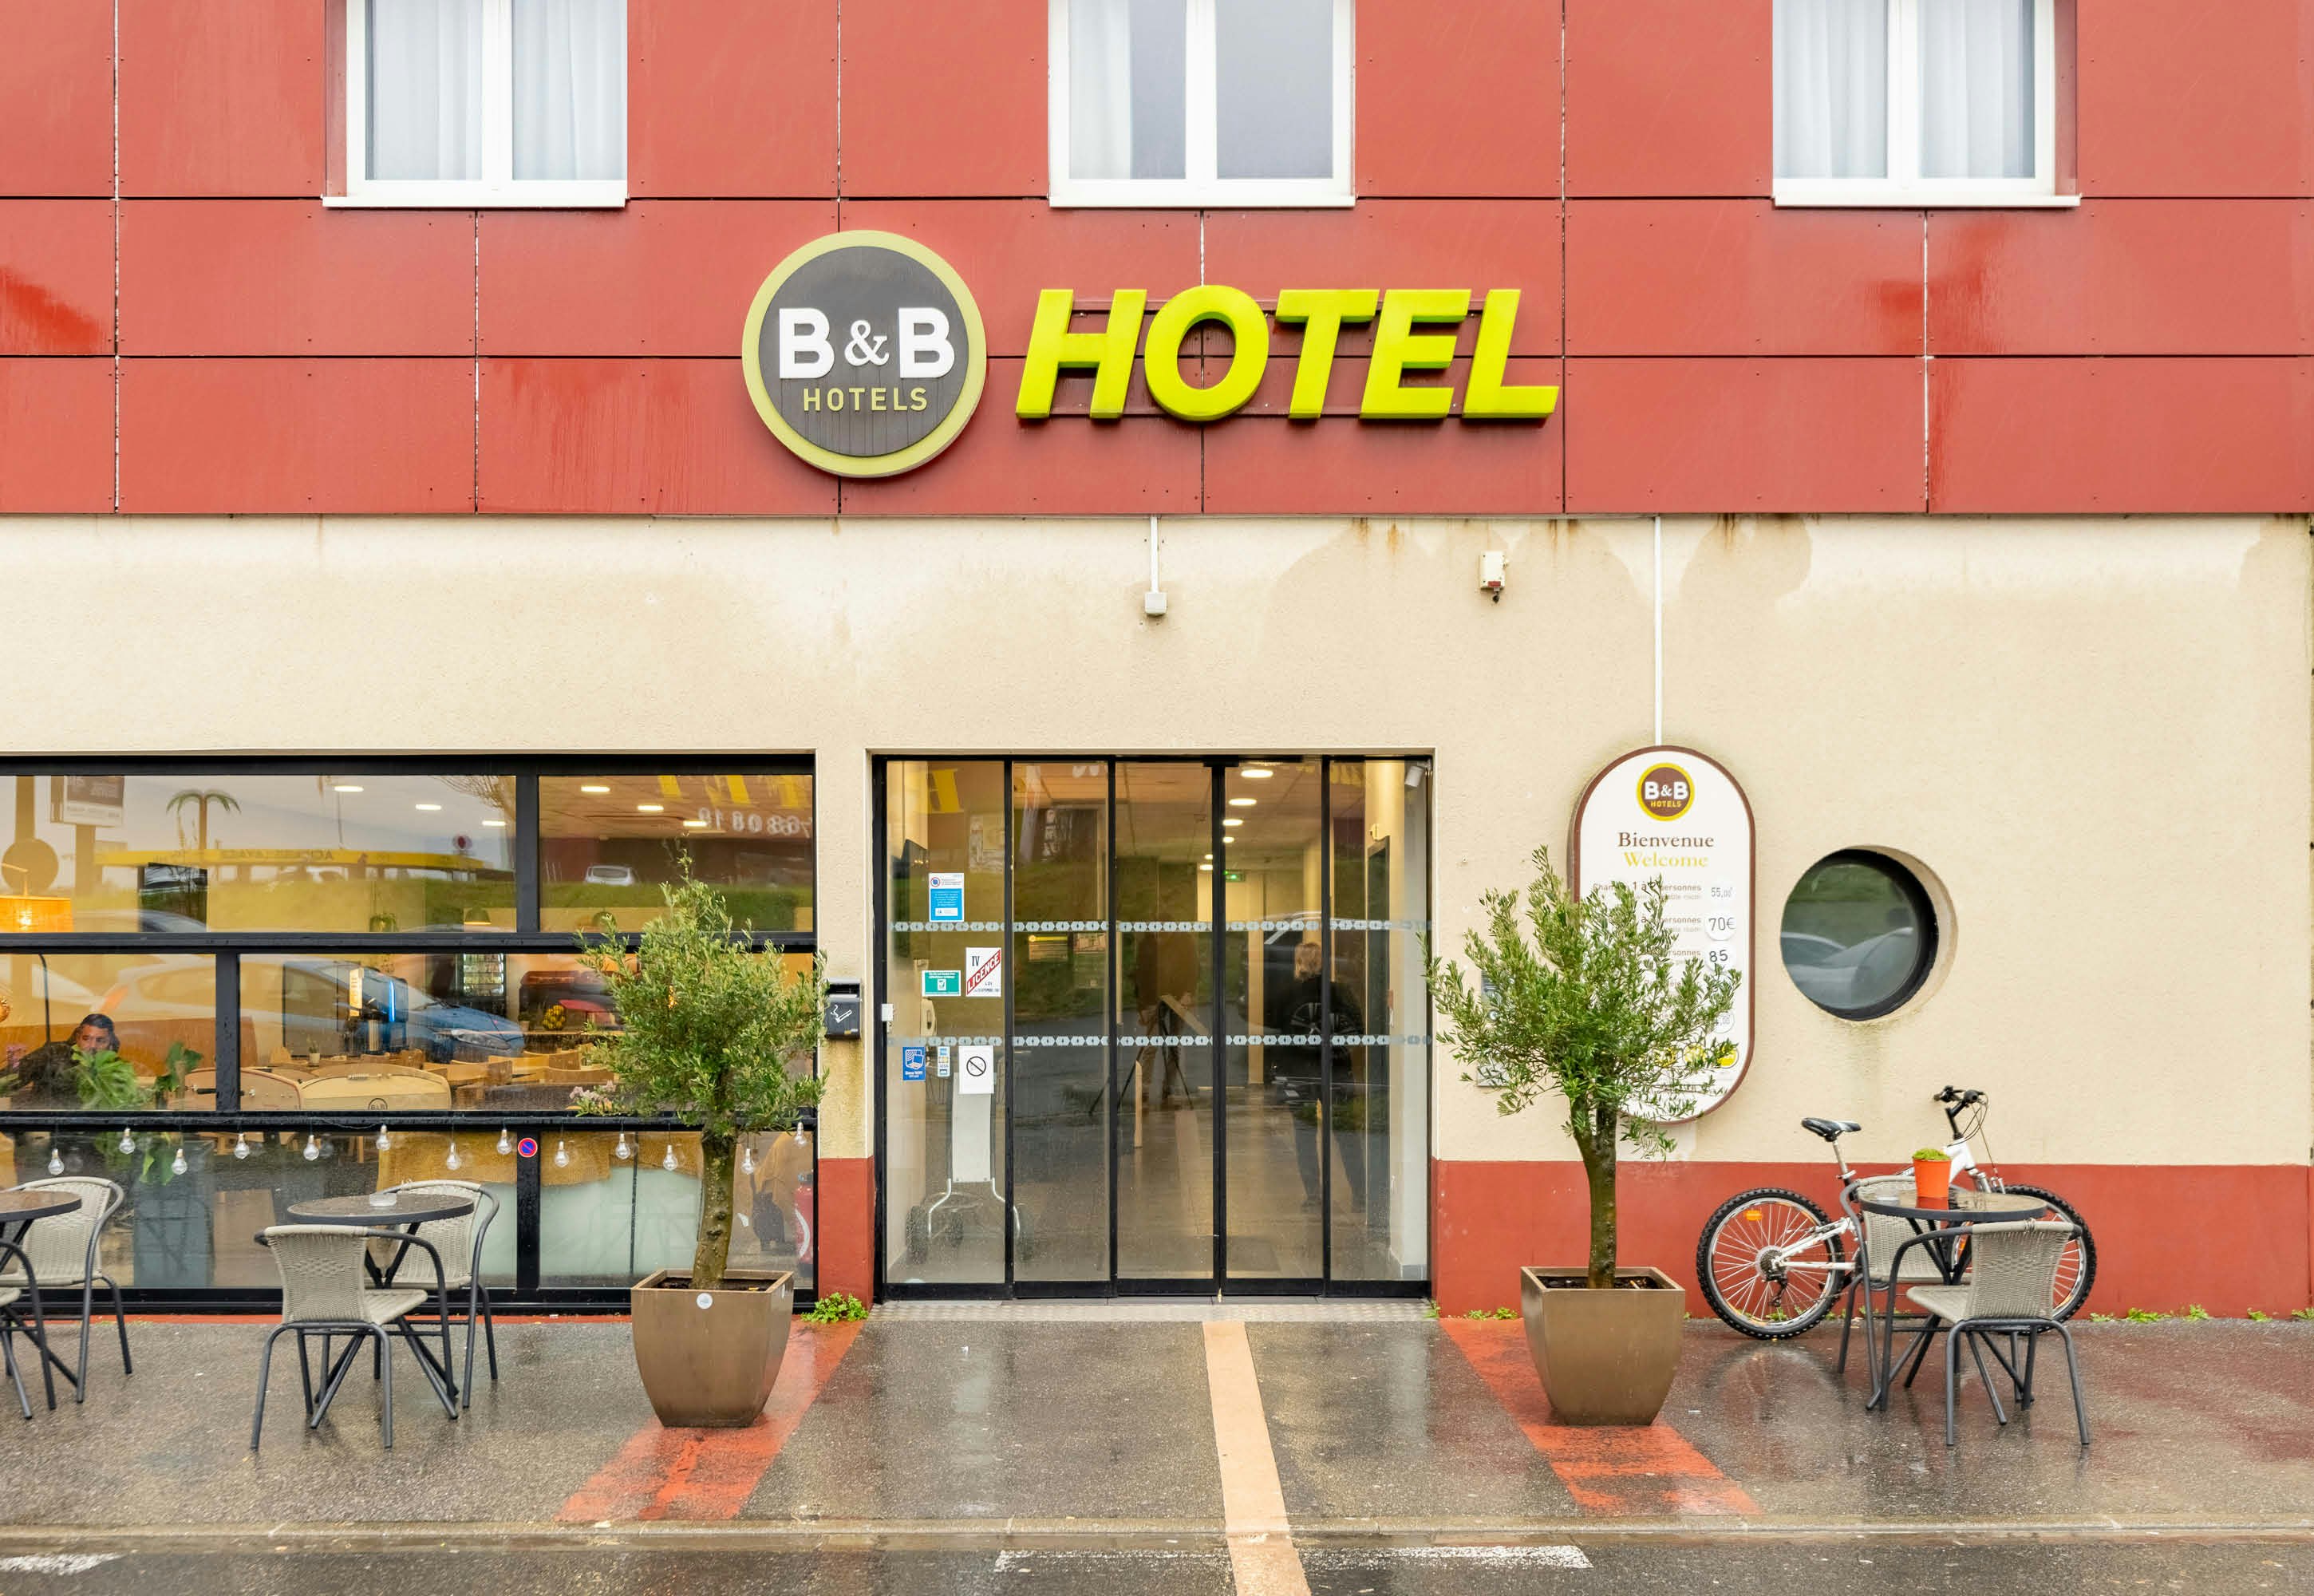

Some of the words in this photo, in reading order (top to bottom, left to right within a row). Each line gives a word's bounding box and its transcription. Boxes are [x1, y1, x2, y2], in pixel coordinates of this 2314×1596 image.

[778, 306, 956, 379] B&B
[1016, 284, 1559, 421] HOTEL
[802, 386, 929, 413] HOTELS
[1645, 781, 1688, 800] B&B
[1617, 832, 1715, 848] Bienvenue
[1624, 851, 1709, 867] Welcome
[1708, 917, 1736, 931] 70€
[972, 955, 980, 966] IV
[1709, 949, 1728, 962] 85
[968, 952, 1001, 991] LICENCE
